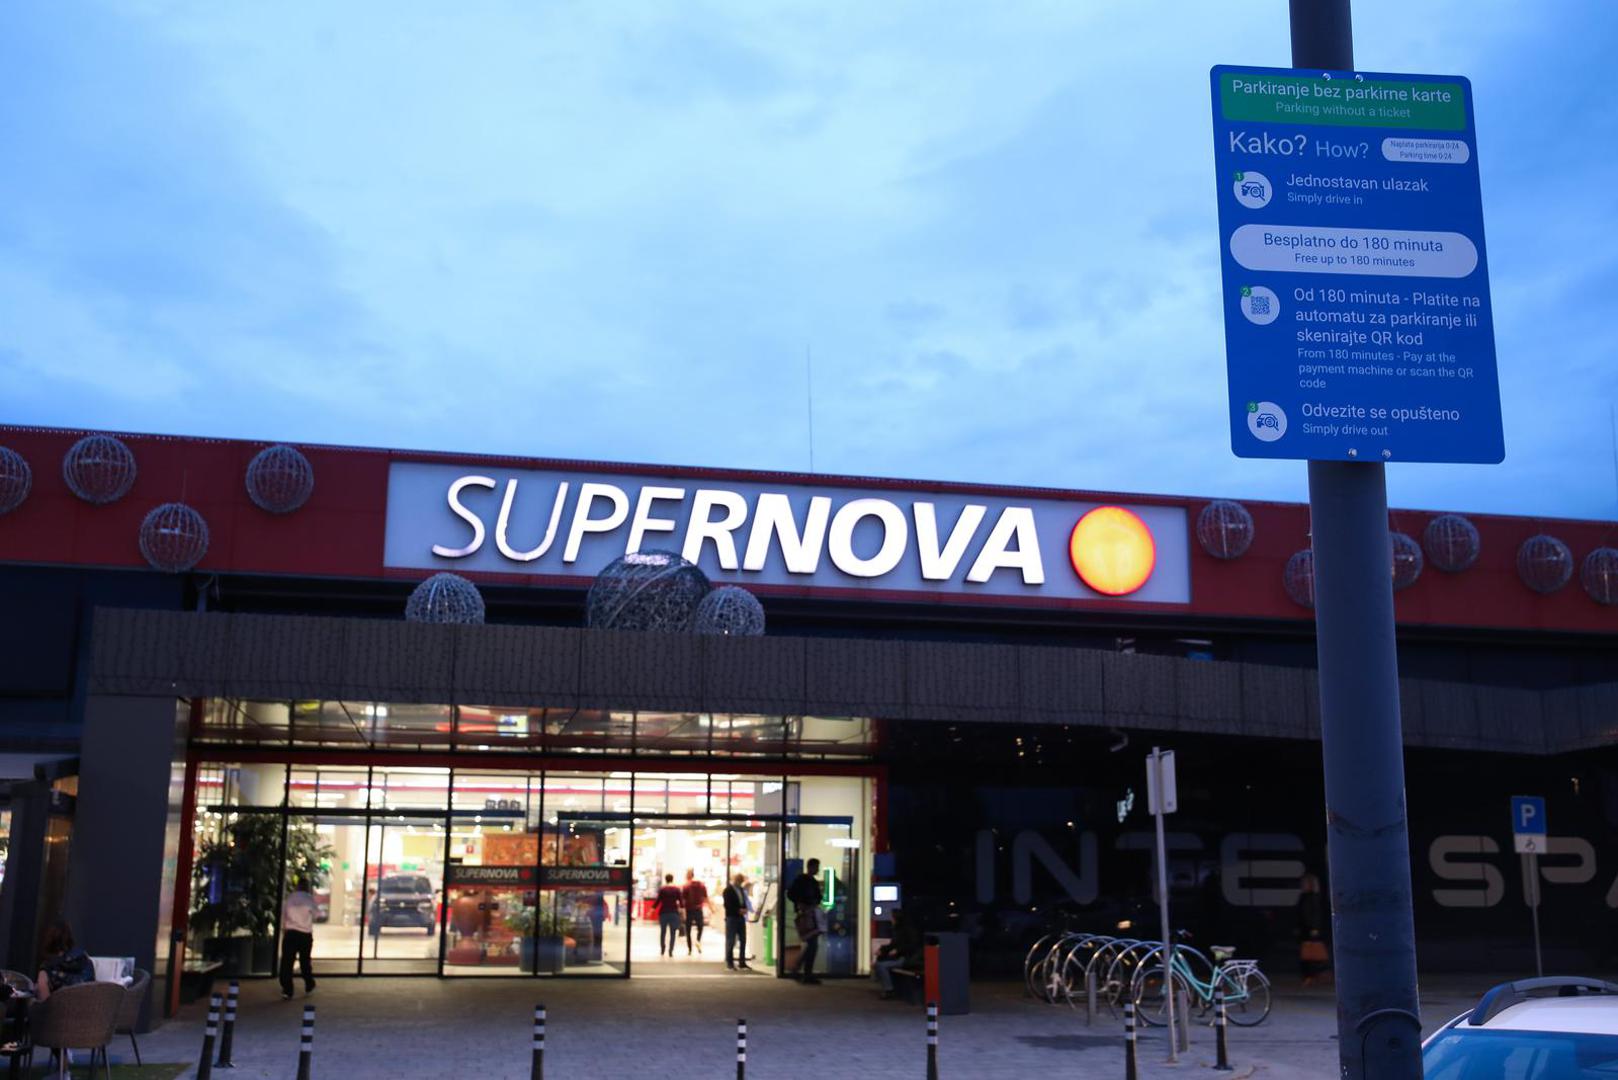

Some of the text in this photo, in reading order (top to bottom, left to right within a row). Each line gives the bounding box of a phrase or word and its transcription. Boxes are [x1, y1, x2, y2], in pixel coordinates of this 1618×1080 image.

[1232, 79, 1451, 102] Parkiranje bez parkirne karte
[1276, 102, 1411, 118] Parking without a ticket
[1229, 131, 1307, 156] Kako?
[1315, 140, 1369, 159] How?
[1287, 174, 1429, 191] Jednostavan ulazak
[1288, 192, 1363, 205] Simply drive in
[1264, 233, 1443, 252] Besplatno do 180 minuta
[1295, 253, 1415, 267] Free up to 180 minutes
[1294, 288, 1314, 302] Od
[1319, 289, 1346, 302] 180
[1350, 290, 1400, 304] minuta
[1413, 292, 1458, 306] Platite
[1463, 296, 1480, 307] na
[1295, 310, 1477, 330] automatu za parkiranje ili
[1297, 328, 1423, 346] skenirajte QR kod
[1297, 348, 1325, 358] From
[1330, 349, 1348, 359] 180
[1352, 350, 1394, 361] minutes
[1403, 351, 1423, 364] Pay
[1426, 353, 1436, 362] at
[1438, 352, 1456, 363] the
[1299, 364, 1474, 379] payment machine or scan the QR
[1299, 378, 1326, 388] code
[1302, 403, 1460, 422] Odvezite se opušteno
[1302, 423, 1388, 437] Simply drive out
[431, 475, 1045, 585] SUPERNOVA
[1520, 803, 1536, 828] P
[455, 868, 518, 880] SUPERNOVA
[547, 868, 610, 880] SUPERNOVA
